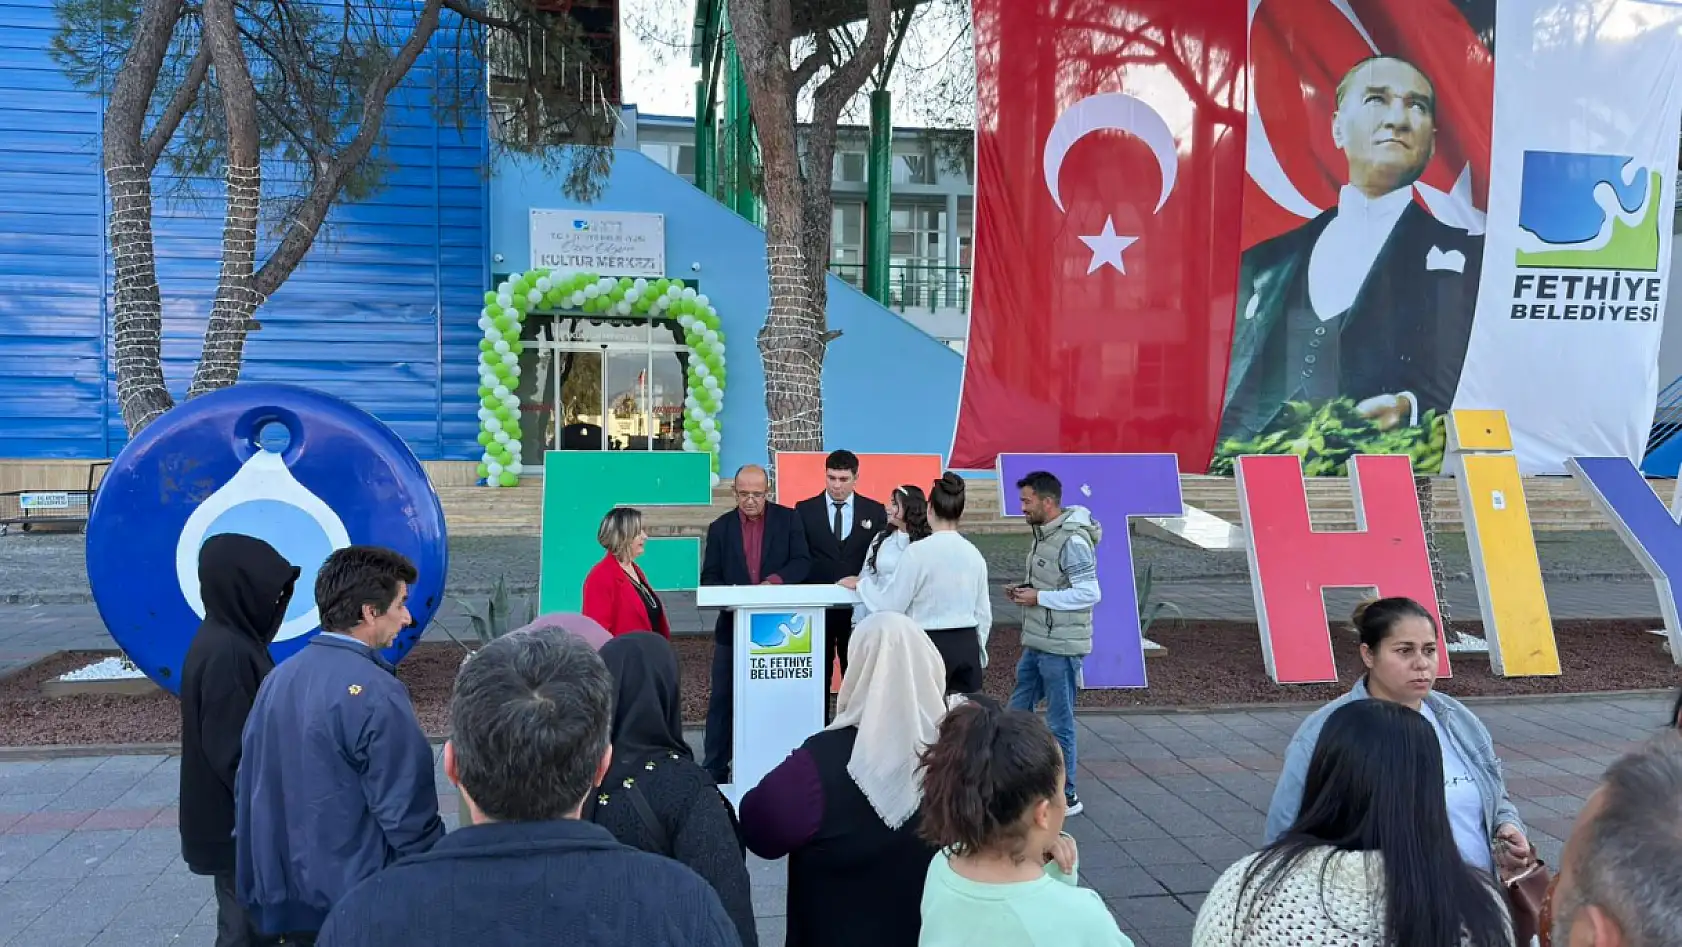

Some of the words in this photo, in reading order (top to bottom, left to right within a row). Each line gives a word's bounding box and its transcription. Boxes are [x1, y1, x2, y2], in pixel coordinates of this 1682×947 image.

[1512, 271, 1661, 302] FETHİYE
[1509, 301, 1658, 322] BELEDİYESİ
[749, 657, 768, 669] T.C.
